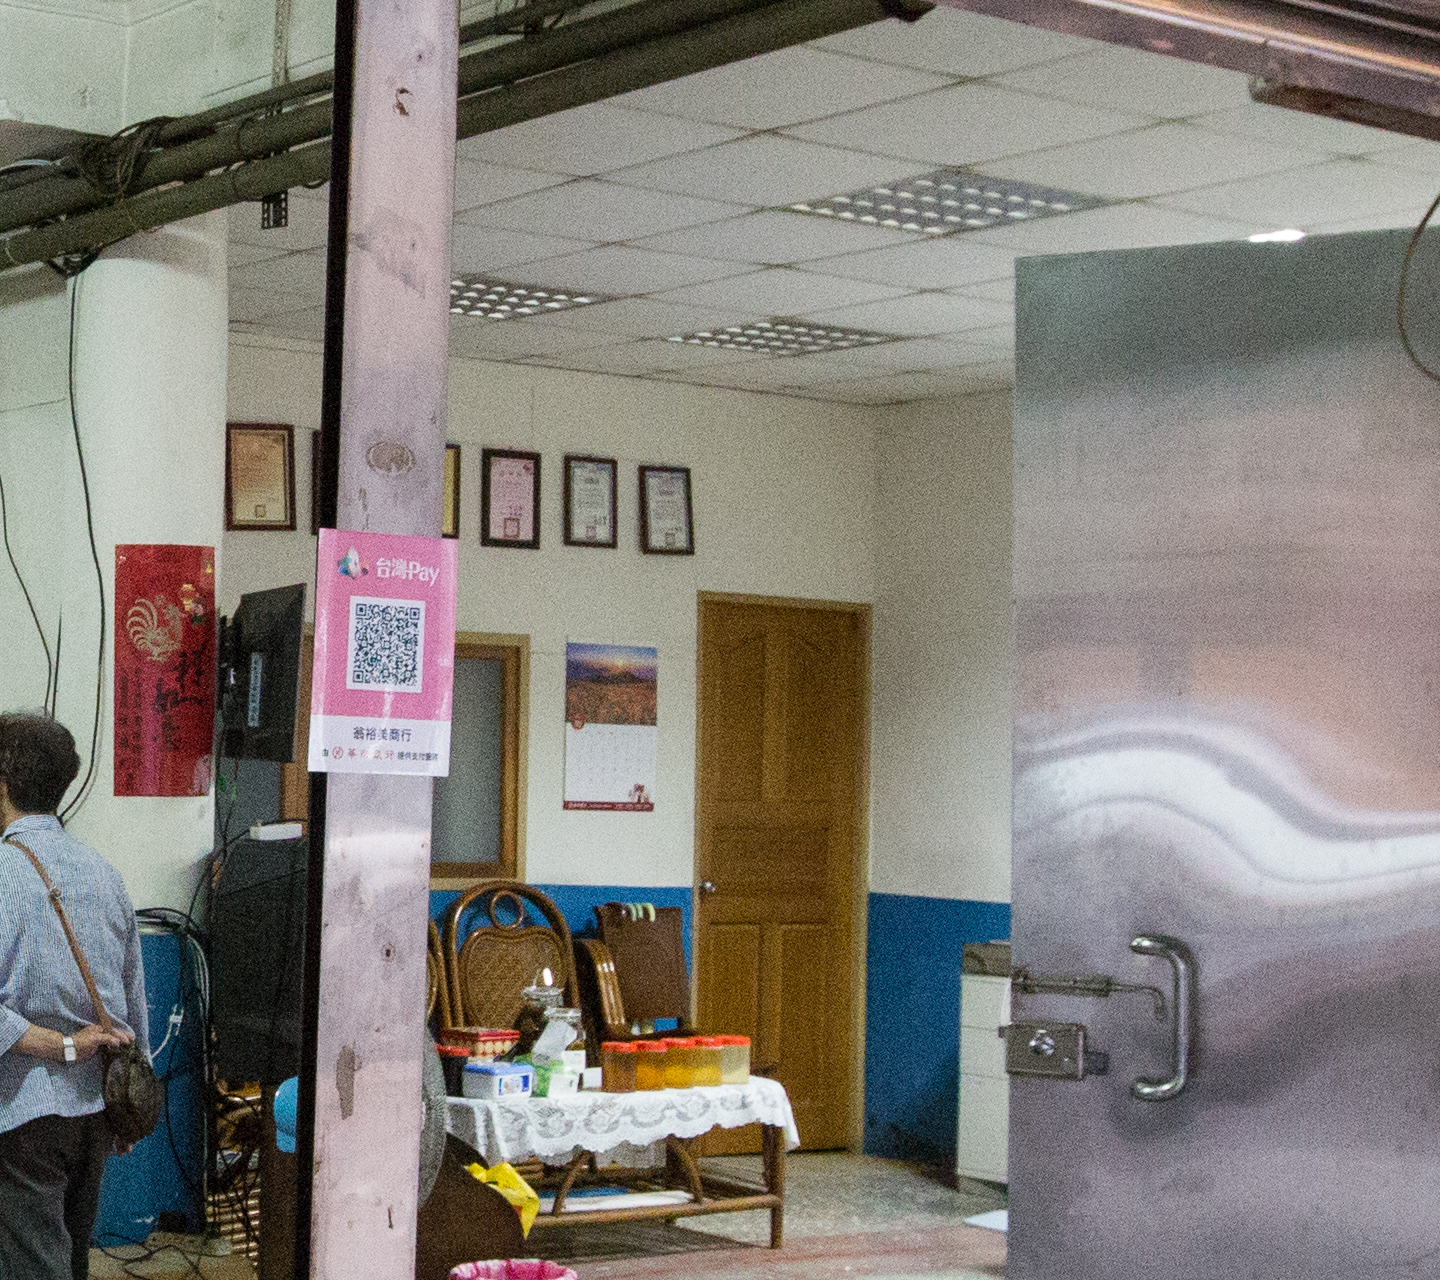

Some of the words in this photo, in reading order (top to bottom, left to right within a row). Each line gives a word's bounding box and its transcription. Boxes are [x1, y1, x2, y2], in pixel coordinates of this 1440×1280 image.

[376, 557, 440, 587] 台灣Pay
[353, 726, 412, 742] 翁裕美商行
